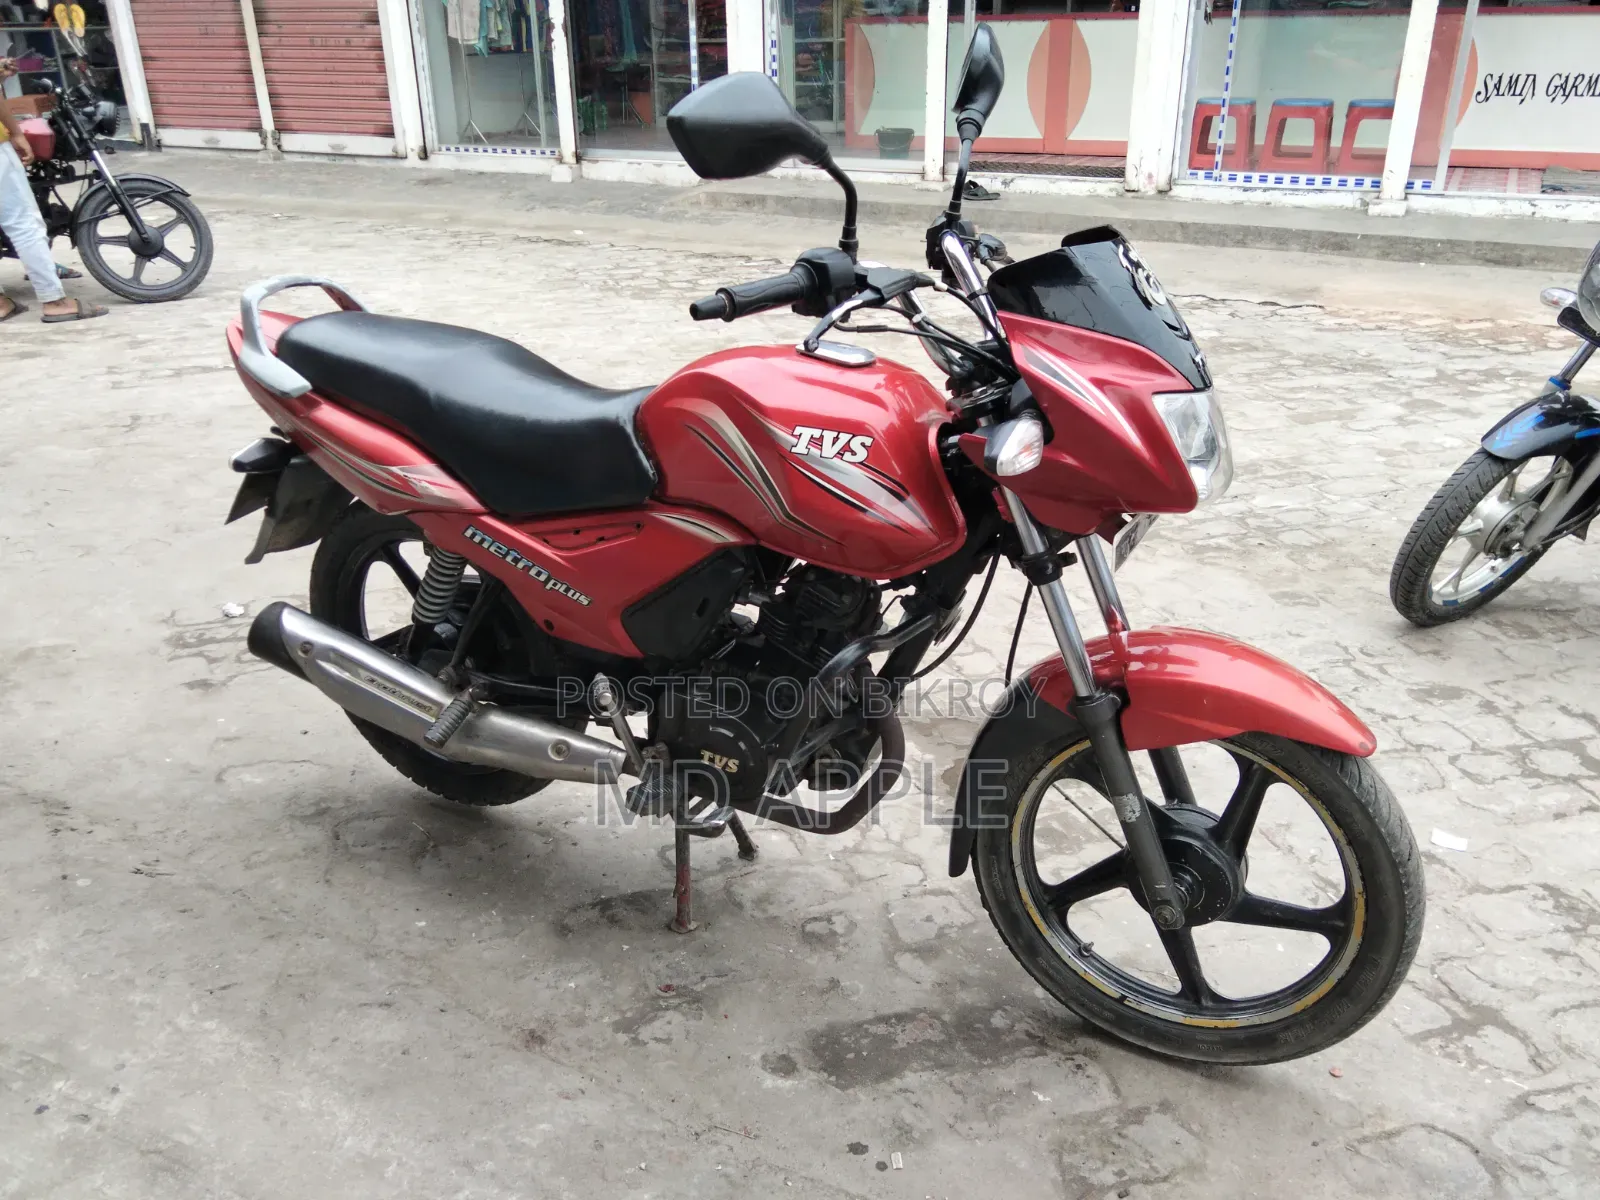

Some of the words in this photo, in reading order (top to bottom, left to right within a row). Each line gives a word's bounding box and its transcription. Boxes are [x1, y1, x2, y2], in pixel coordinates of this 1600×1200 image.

[789, 424, 875, 464] TVS
[462, 524, 549, 582] metro
[545, 576, 592, 607] plus
[700, 749, 740, 773] TVS
